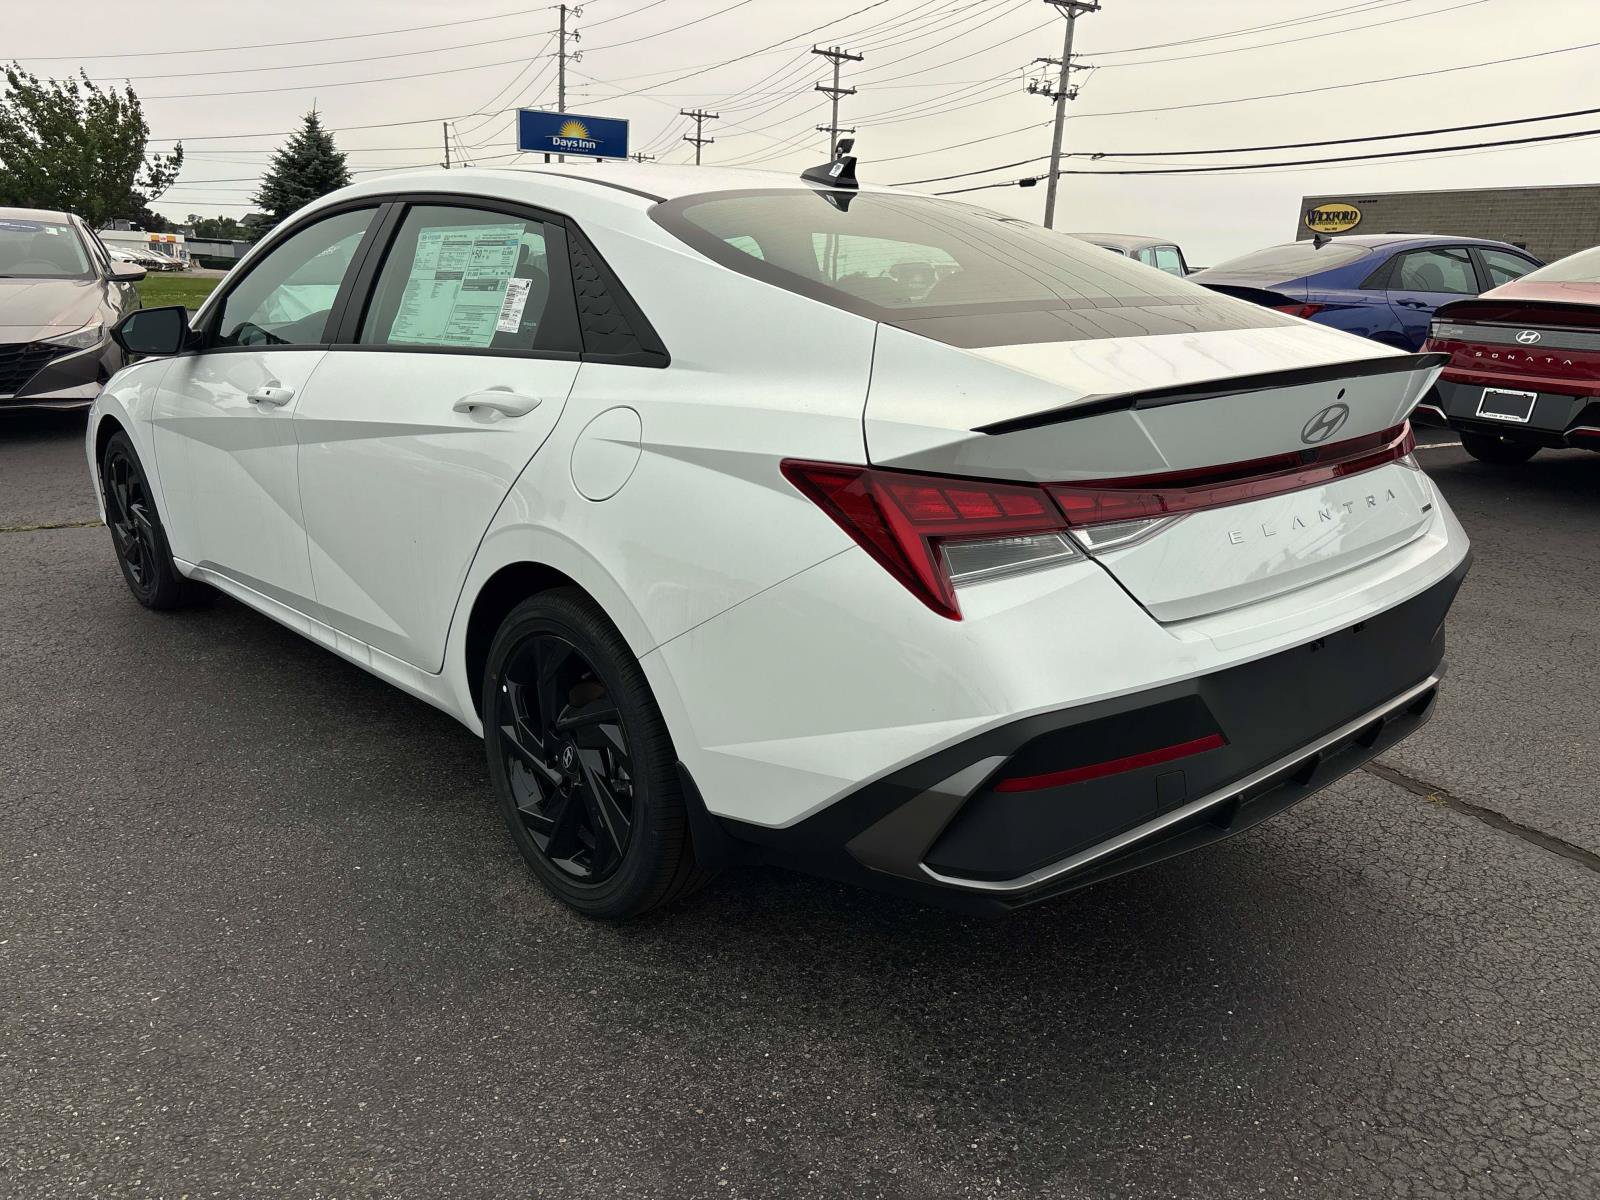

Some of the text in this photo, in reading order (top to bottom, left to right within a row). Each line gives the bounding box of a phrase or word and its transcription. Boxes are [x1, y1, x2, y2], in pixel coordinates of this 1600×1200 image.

[552, 137, 596, 149] Days Inn
[1475, 351, 1572, 366] SONATA
[1228, 488, 1396, 545] ELANTRA
